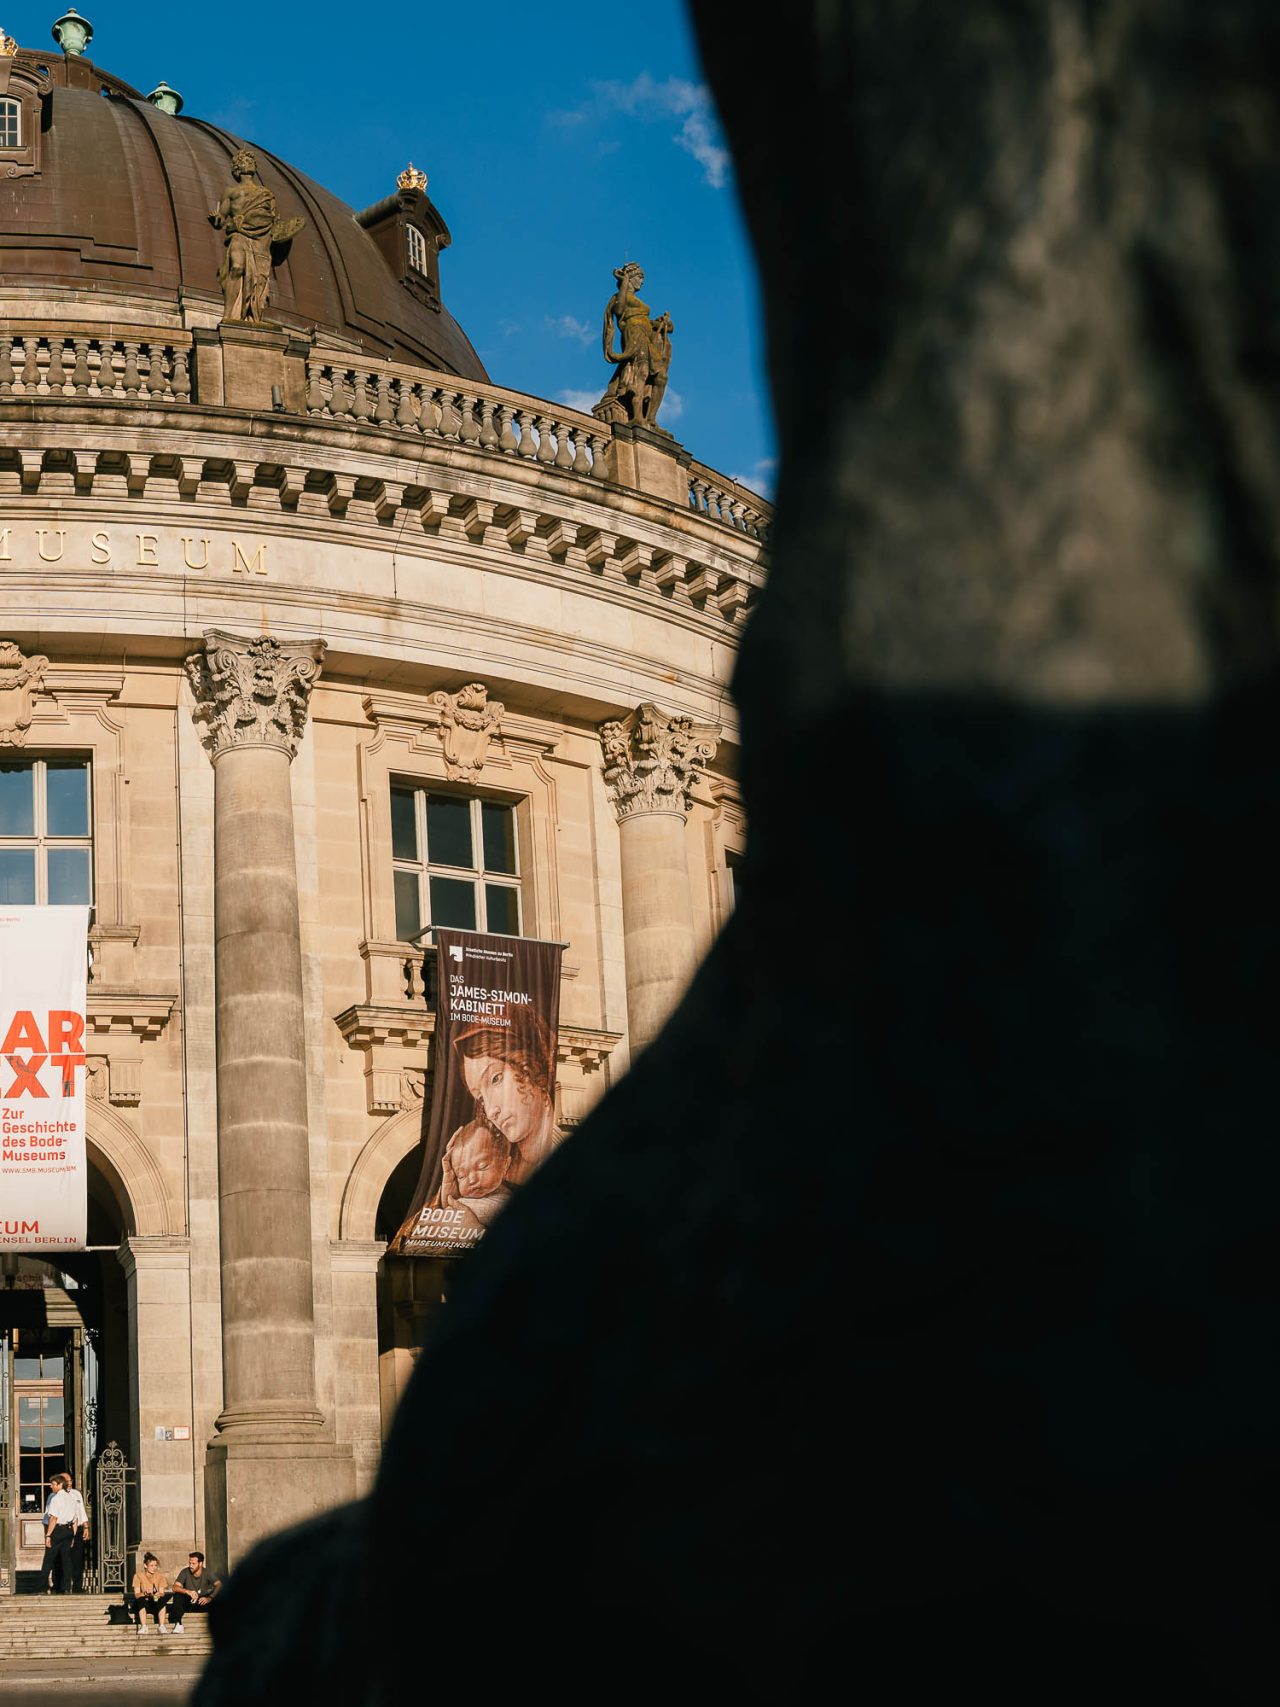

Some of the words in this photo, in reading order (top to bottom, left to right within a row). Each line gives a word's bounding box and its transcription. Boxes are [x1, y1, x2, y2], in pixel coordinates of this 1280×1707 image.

[450, 974, 464, 983] DAS
[450, 985, 532, 1005] JAMES-SIMON-
[450, 998, 505, 1015] KABINETT
[462, 1014, 511, 1026] BODE-MUSEUM
[2, 1108, 25, 1120] Zur
[2, 1121, 77, 1134] Geschichte
[2, 1137, 26, 1148] des
[29, 1135, 67, 1147] Bode-
[2, 1150, 66, 1161] Museums
[419, 1207, 465, 1223] BODE
[411, 1225, 486, 1240] MUSEUM
